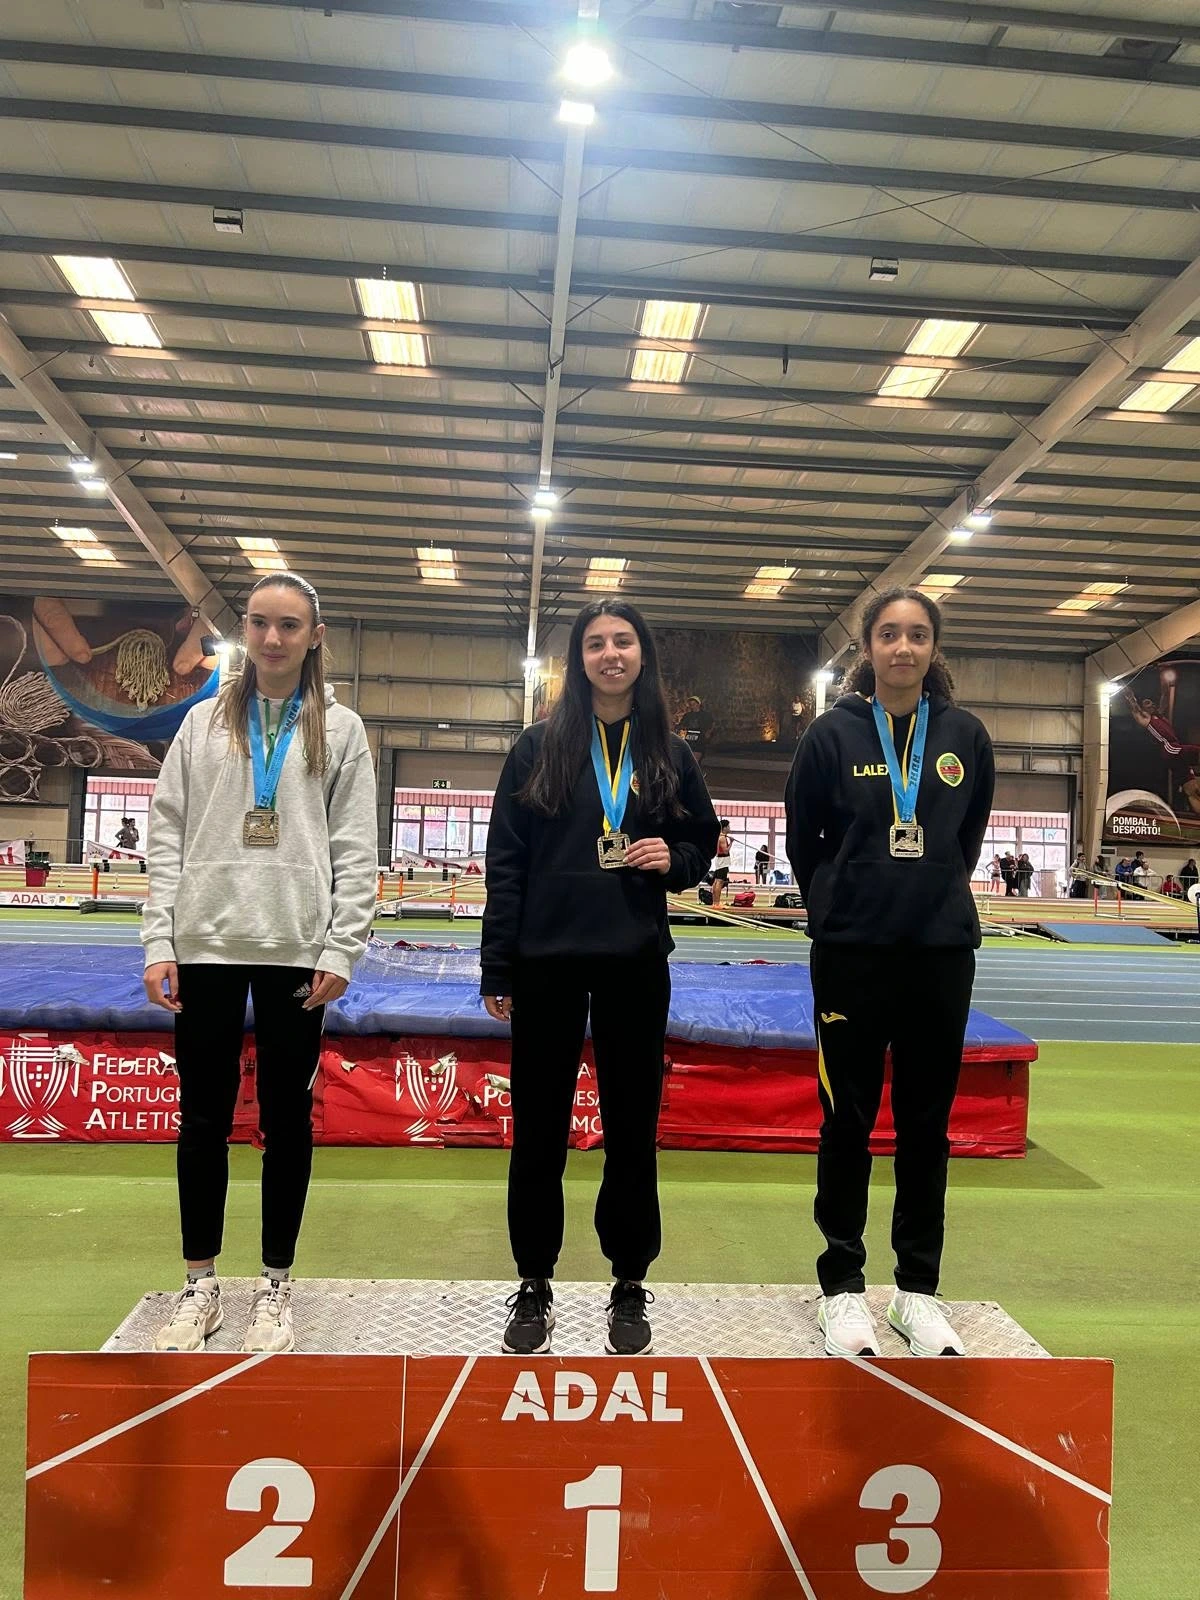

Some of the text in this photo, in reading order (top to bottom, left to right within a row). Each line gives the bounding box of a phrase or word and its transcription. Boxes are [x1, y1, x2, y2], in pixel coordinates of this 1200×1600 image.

[1113, 816, 1149, 825] POMBAL
[1113, 825, 1161, 835] DESPORTO!
[11, 894, 48, 904] ADAL
[93, 1053, 178, 1075] FEDERA
[91, 1081, 181, 1103] PORTUG
[84, 1108, 182, 1130] ATLETIS
[501, 1371, 683, 1422] ADAL
[224, 1457, 315, 1587] 2
[564, 1465, 622, 1591] 1
[855, 1464, 942, 1594] 3
